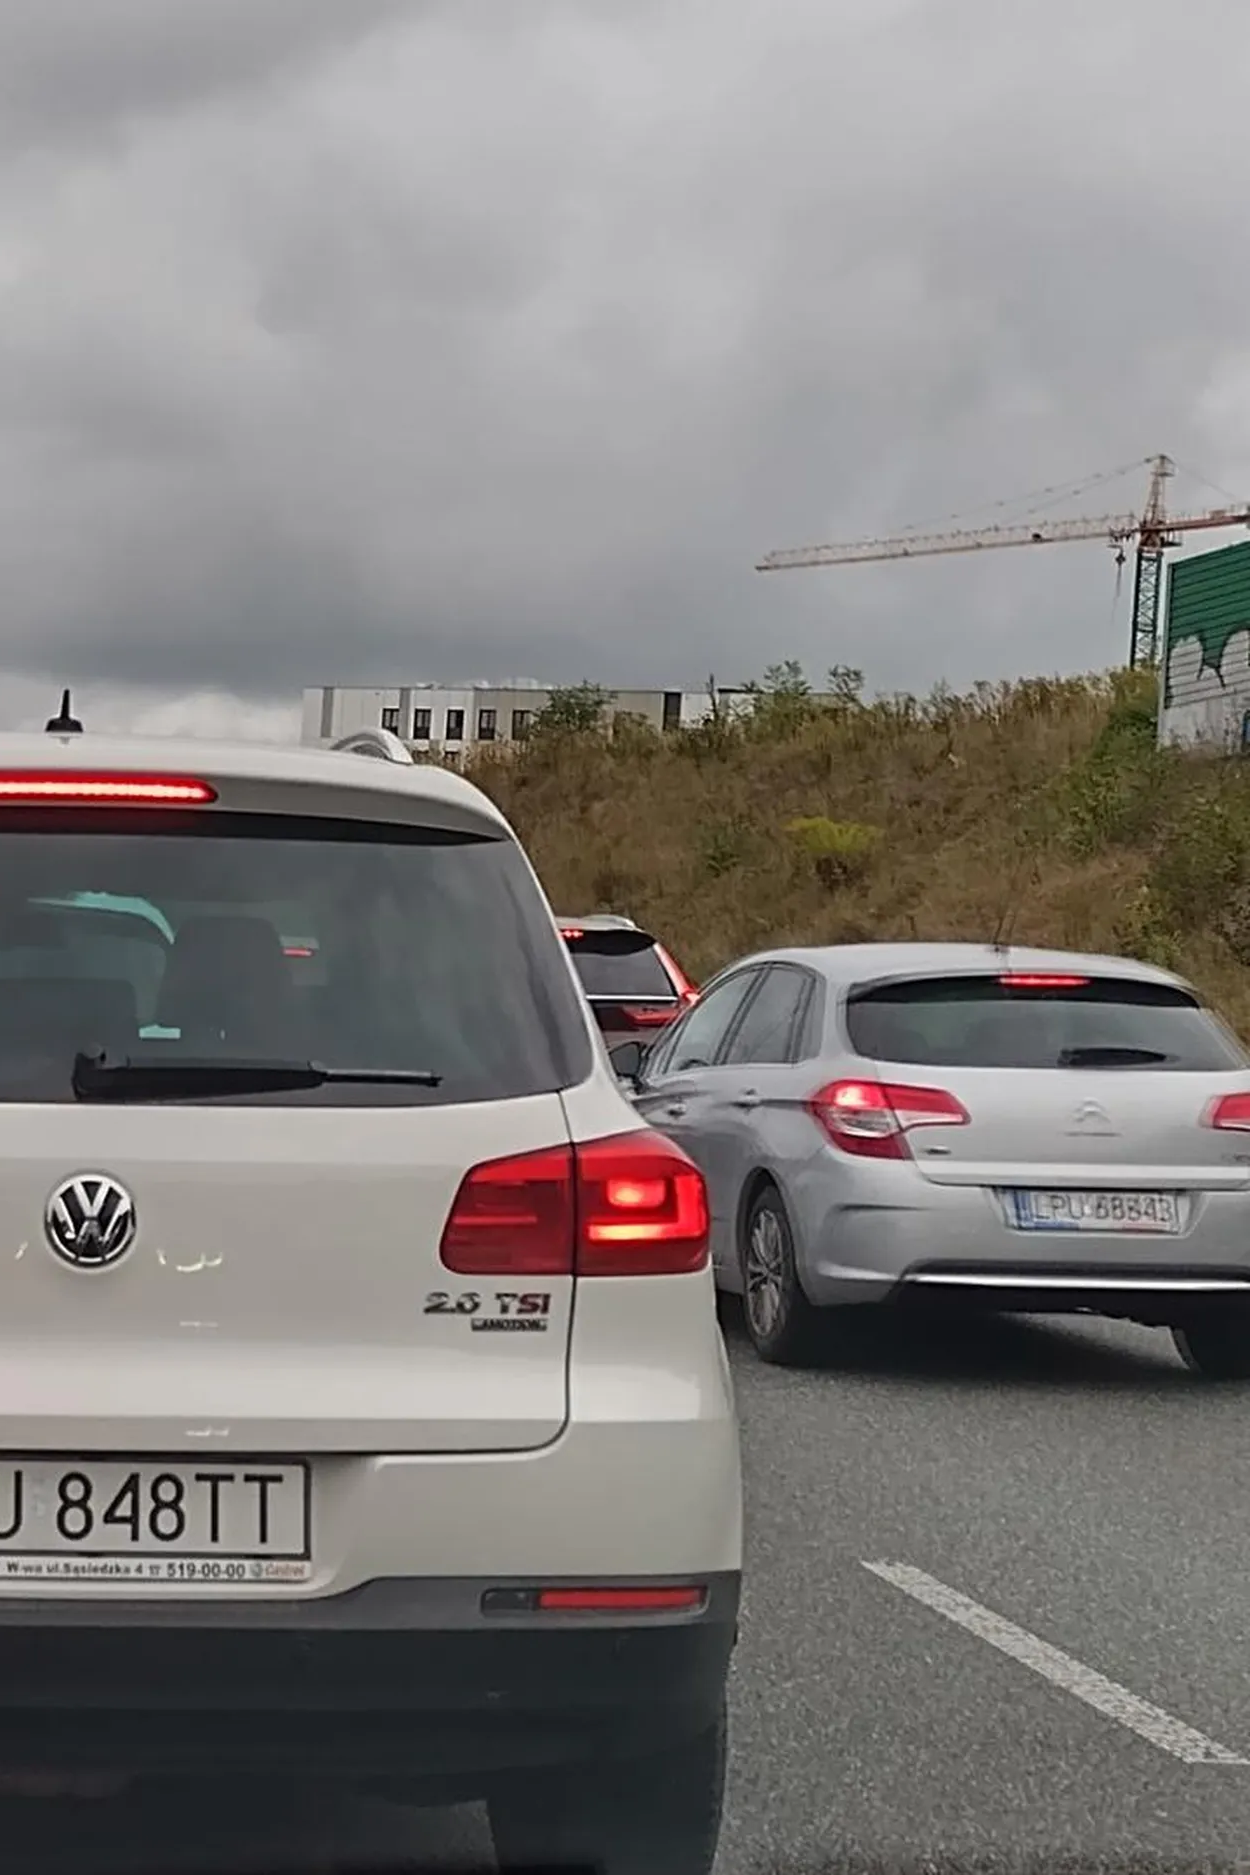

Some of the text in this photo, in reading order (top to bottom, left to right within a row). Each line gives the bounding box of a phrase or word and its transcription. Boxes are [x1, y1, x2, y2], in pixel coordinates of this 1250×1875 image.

[1035, 1195, 1085, 1220] LPU
[494, 1292, 551, 1315] TSI
[55, 1470, 284, 1543] 848TT
[166, 1562, 246, 1578] 519-00-00
